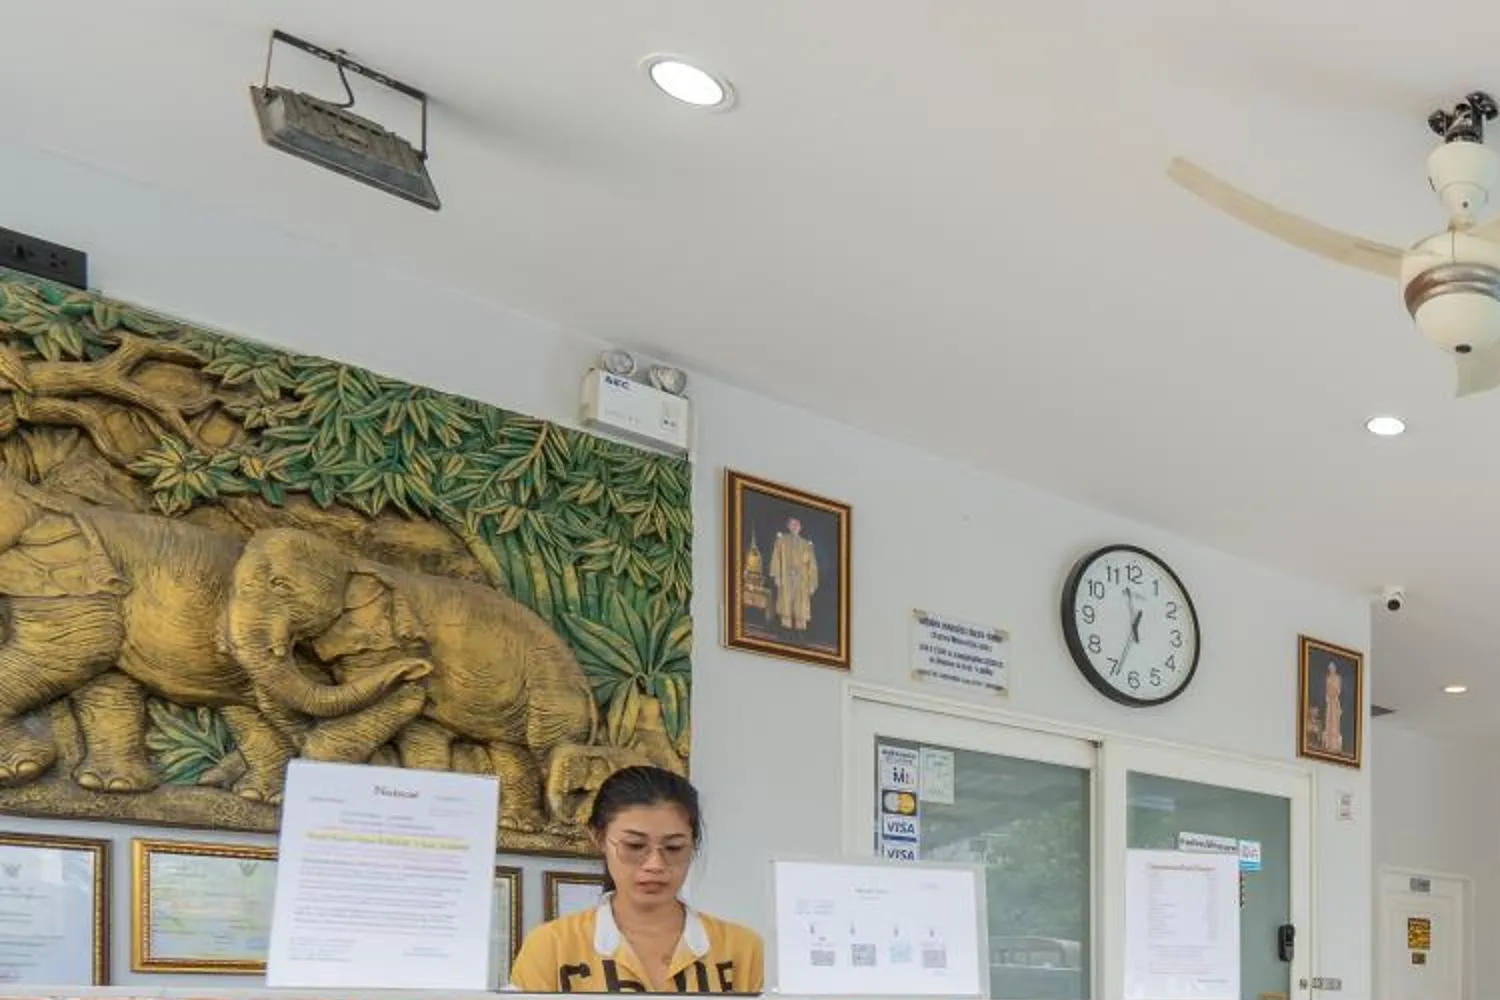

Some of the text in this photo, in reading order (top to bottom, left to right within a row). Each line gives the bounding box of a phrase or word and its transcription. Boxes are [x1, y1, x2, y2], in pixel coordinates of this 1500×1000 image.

[1106, 565, 1120, 585] 11
[1125, 564, 1143, 584] 12
[1088, 579, 1105, 600] 10
[1152, 579, 1159, 596] 1
[1082, 604, 1095, 624] 9
[1165, 601, 1177, 620] 2
[1087, 633, 1101, 654] 8
[1170, 629, 1182, 648] 3
[1107, 657, 1118, 676] 7
[1165, 654, 1176, 672] 4
[1127, 671, 1141, 689] 6
[1150, 667, 1161, 686] 5
[887, 822, 915, 834] VISA
[887, 849, 915, 860] VISA
